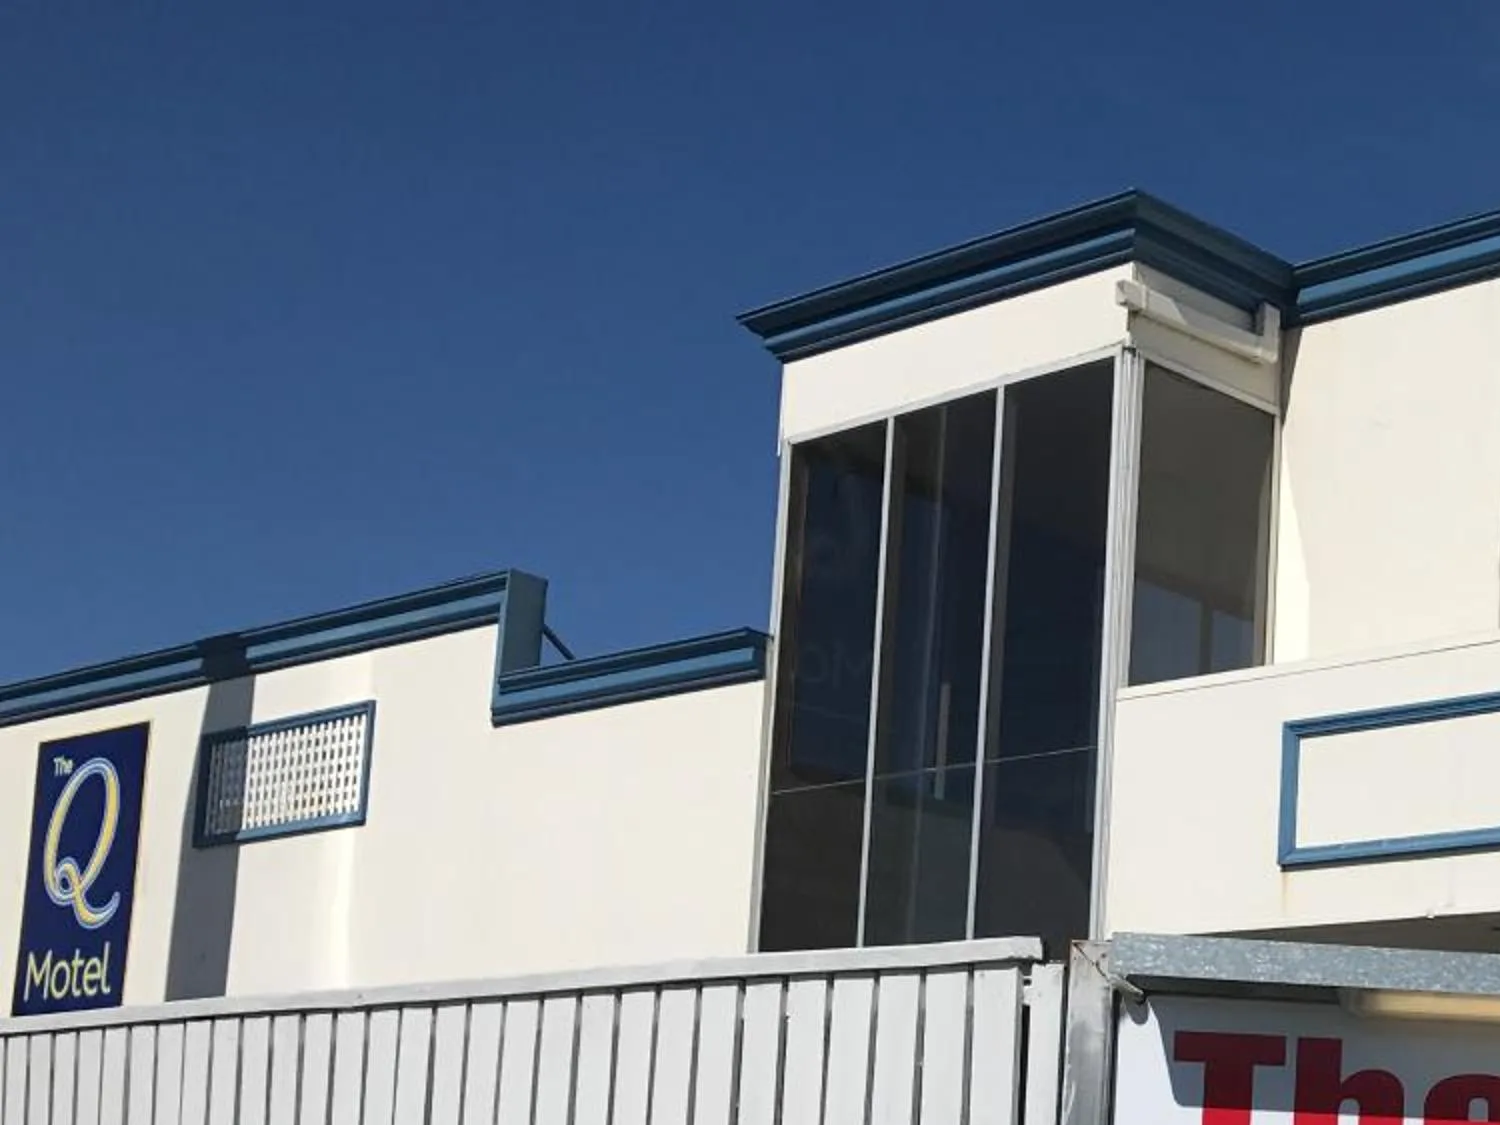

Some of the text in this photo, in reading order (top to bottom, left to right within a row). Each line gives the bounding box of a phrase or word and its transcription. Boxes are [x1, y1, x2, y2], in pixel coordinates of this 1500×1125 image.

[53, 756, 73, 776] The
[43, 757, 120, 928] Q
[23, 941, 111, 1002] Motel
